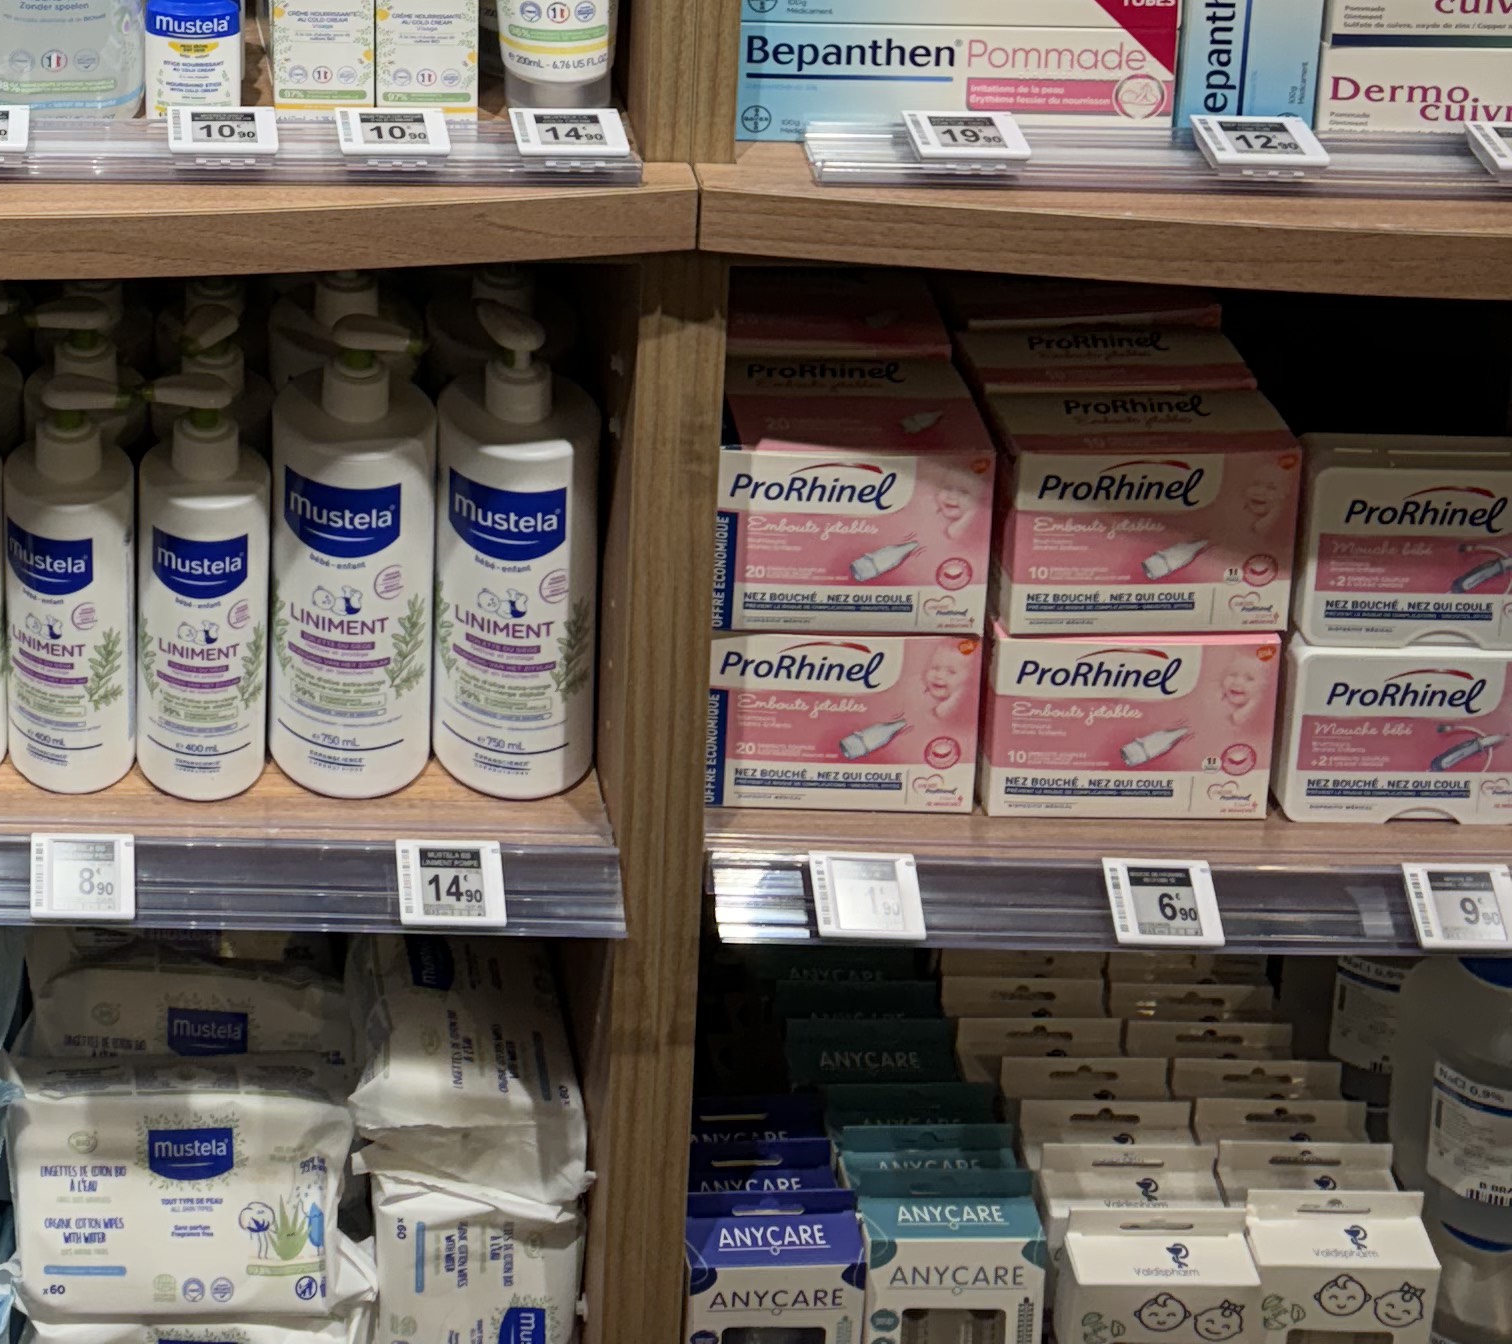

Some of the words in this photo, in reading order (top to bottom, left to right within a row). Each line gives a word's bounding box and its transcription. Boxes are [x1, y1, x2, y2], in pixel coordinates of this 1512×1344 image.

[156, 15, 228, 34] Mustela
[746, 35, 955, 71] Bepanthen
[968, 40, 1146, 71] Pommade
[730, 472, 897, 511] ProRhinel
[1038, 468, 1204, 507] ProRhinel
[1026, 593, 1049, 603] NEZ
[1053, 590, 1100, 603] BOUCHÉ
[290, 602, 389, 636] LINIMENT
[455, 604, 555, 640] LINIMENT
[1017, 657, 1183, 694] ProRhinel
[1327, 680, 1487, 714] ProRhinel
[154, 1140, 227, 1157] Mustela
[898, 1206, 1005, 1224] ANYCARE
[719, 1225, 826, 1247] ANYCARE
[710, 1289, 845, 1309] ANYCARE
